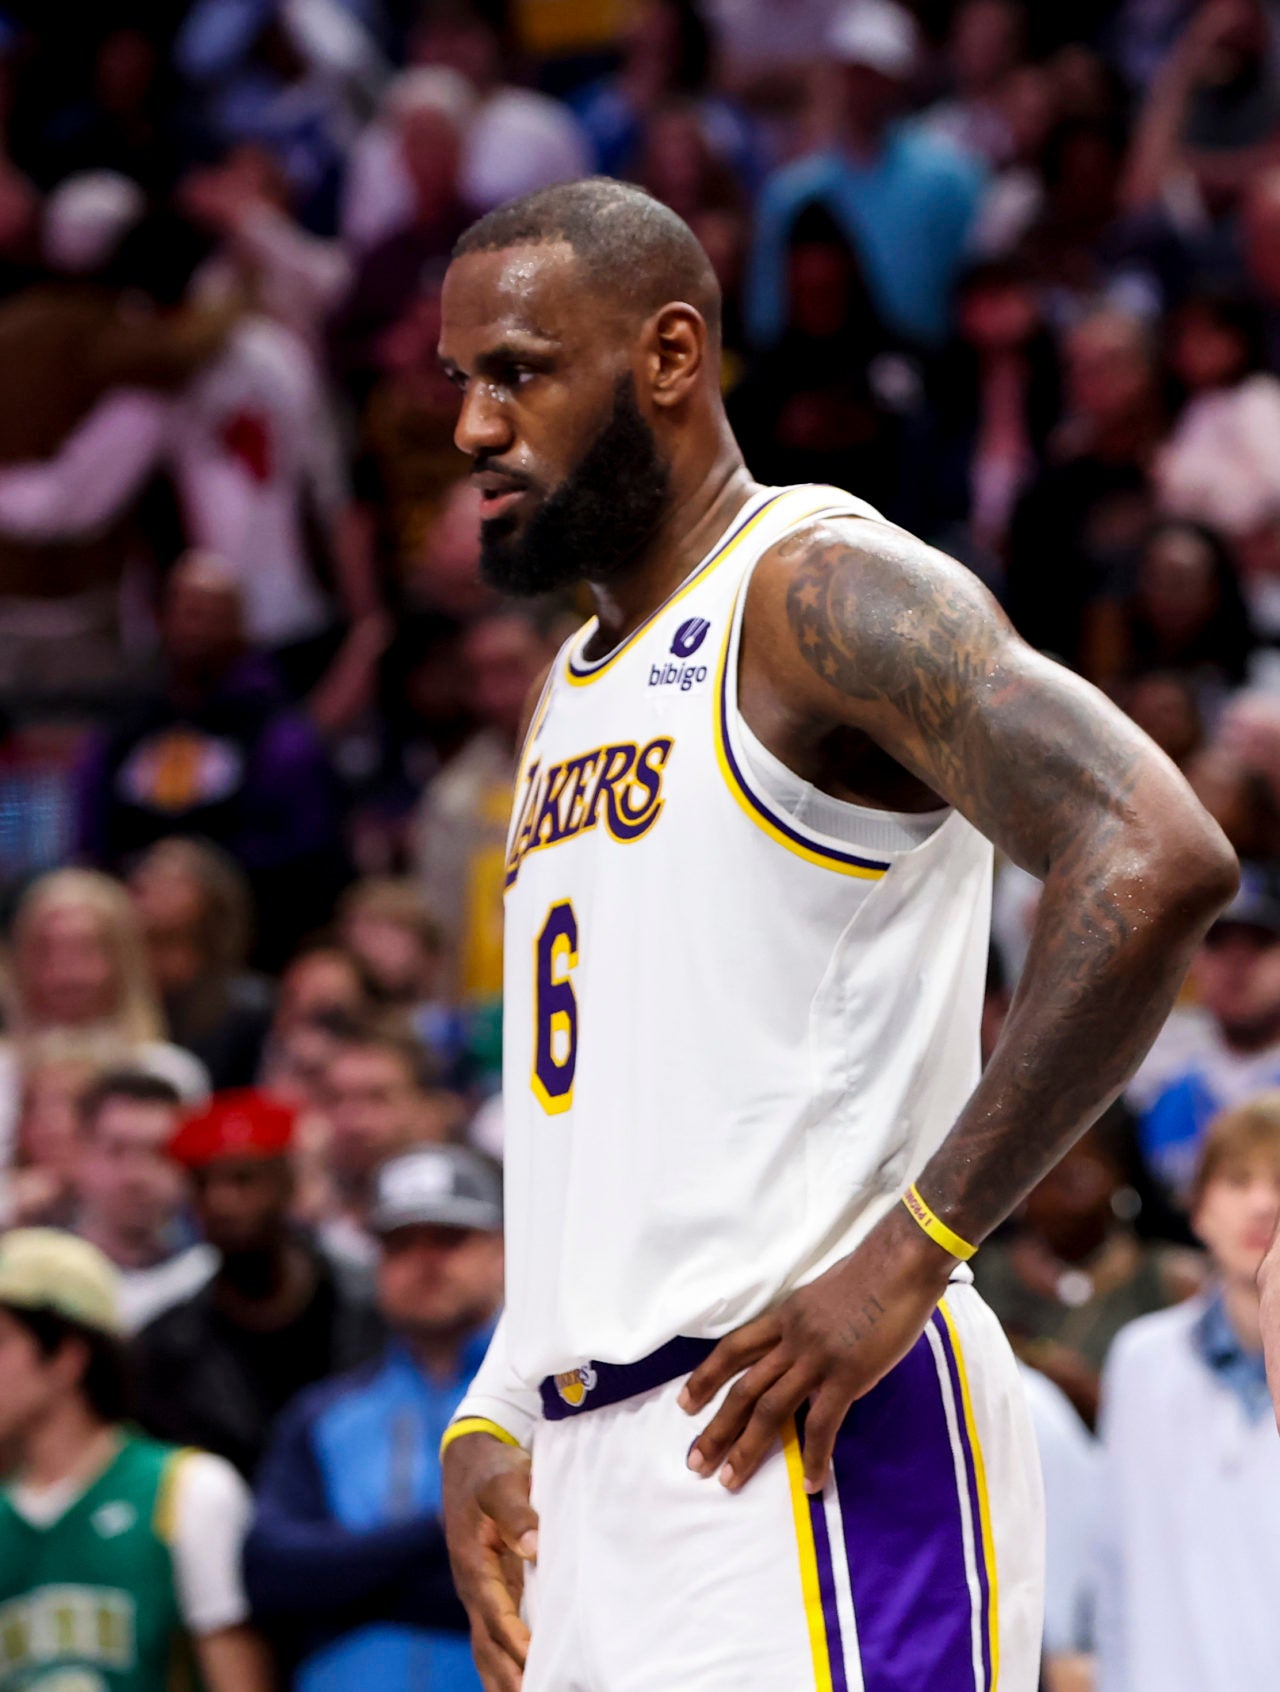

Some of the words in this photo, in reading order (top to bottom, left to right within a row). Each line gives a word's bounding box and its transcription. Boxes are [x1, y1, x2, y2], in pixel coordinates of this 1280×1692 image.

[648, 662, 708, 692] bibigo
[503, 735, 675, 894] AKERS
[529, 896, 579, 1116] 6
